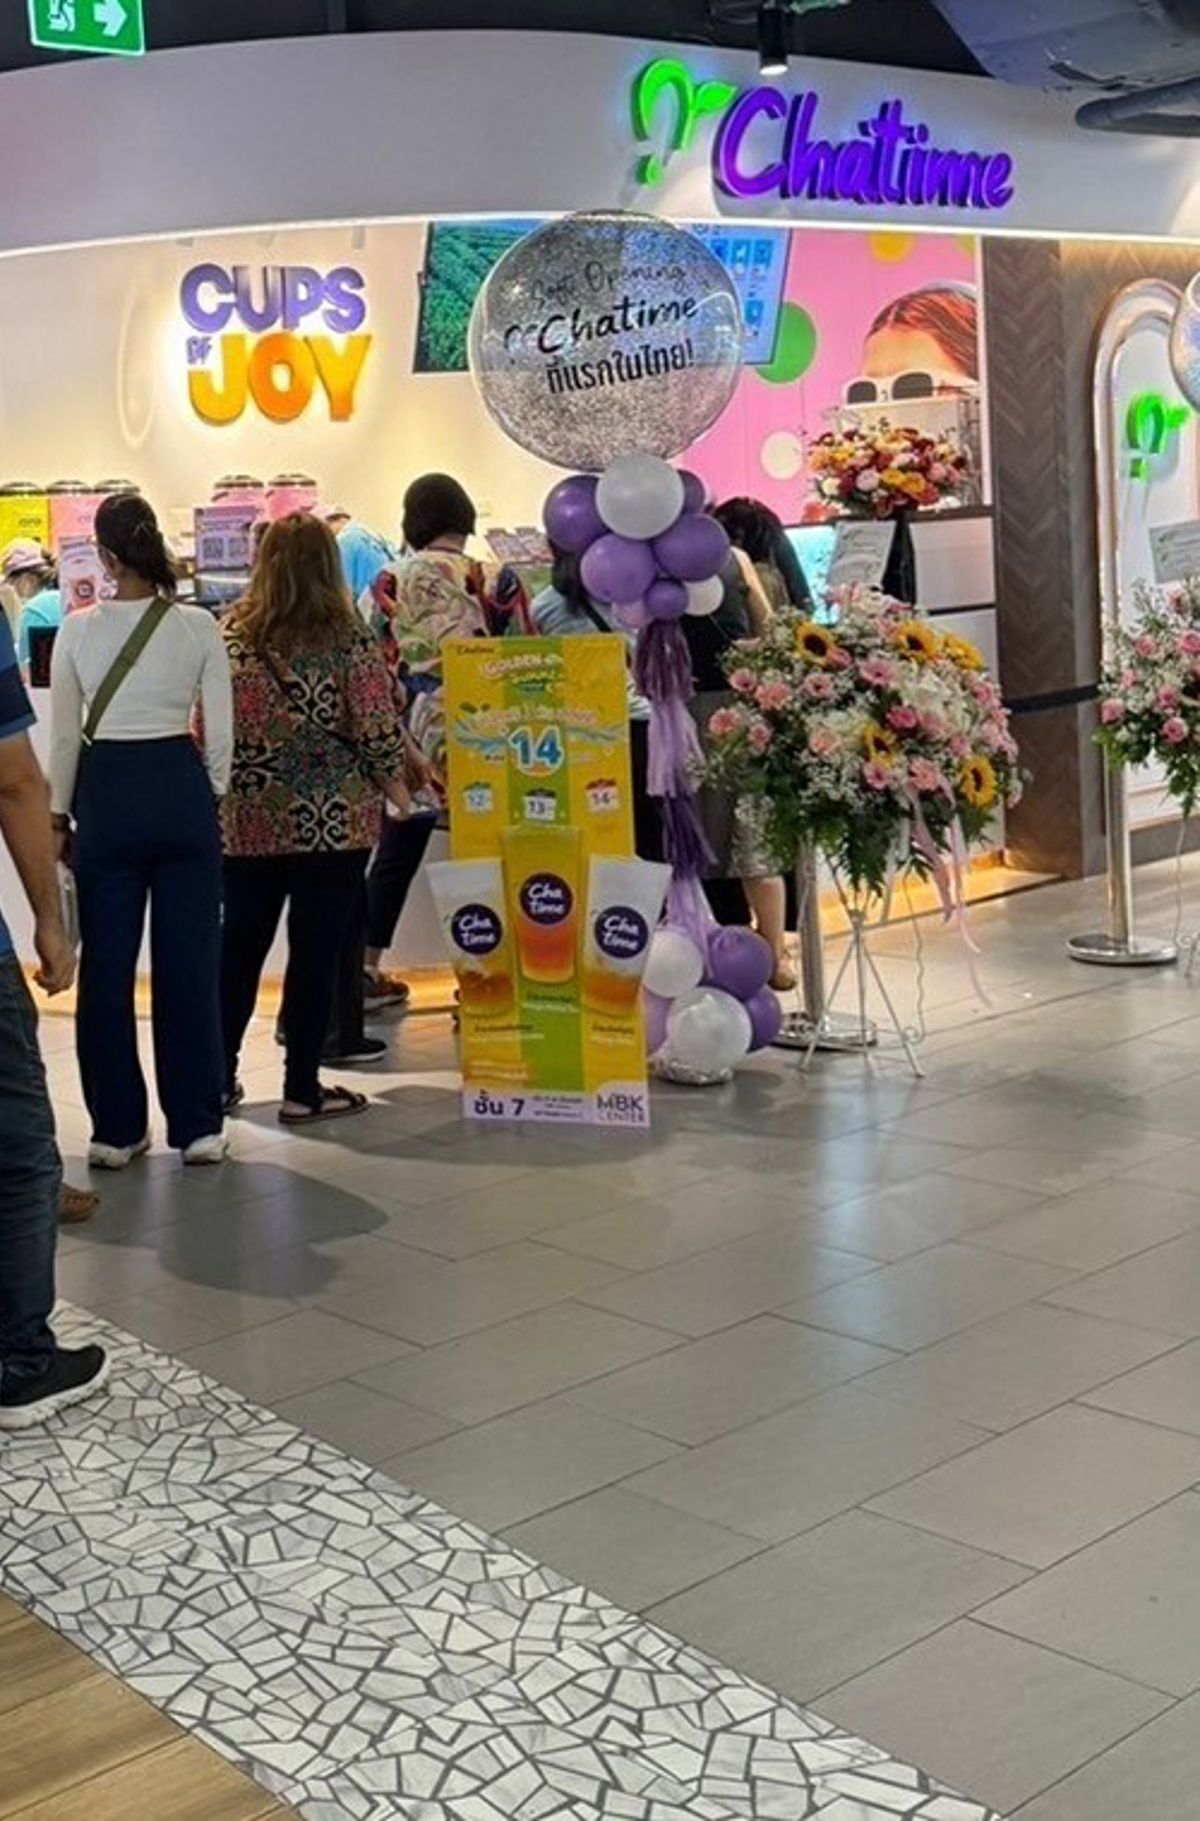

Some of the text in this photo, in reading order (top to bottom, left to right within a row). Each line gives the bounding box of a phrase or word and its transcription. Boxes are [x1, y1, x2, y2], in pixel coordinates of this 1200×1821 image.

[711, 86, 1014, 208] Chatime
[180, 263, 366, 333] CUPS
[538, 295, 699, 354] Chatime
[188, 332, 372, 427] JOY
[509, 726, 564, 768] 14
[529, 882, 563, 898] Cha
[459, 913, 492, 930] Cha
[604, 915, 639, 935] Cha
[474, 1089, 503, 1115] ชั้น
[511, 1098, 525, 1116] 7
[597, 1093, 644, 1112] MBK
